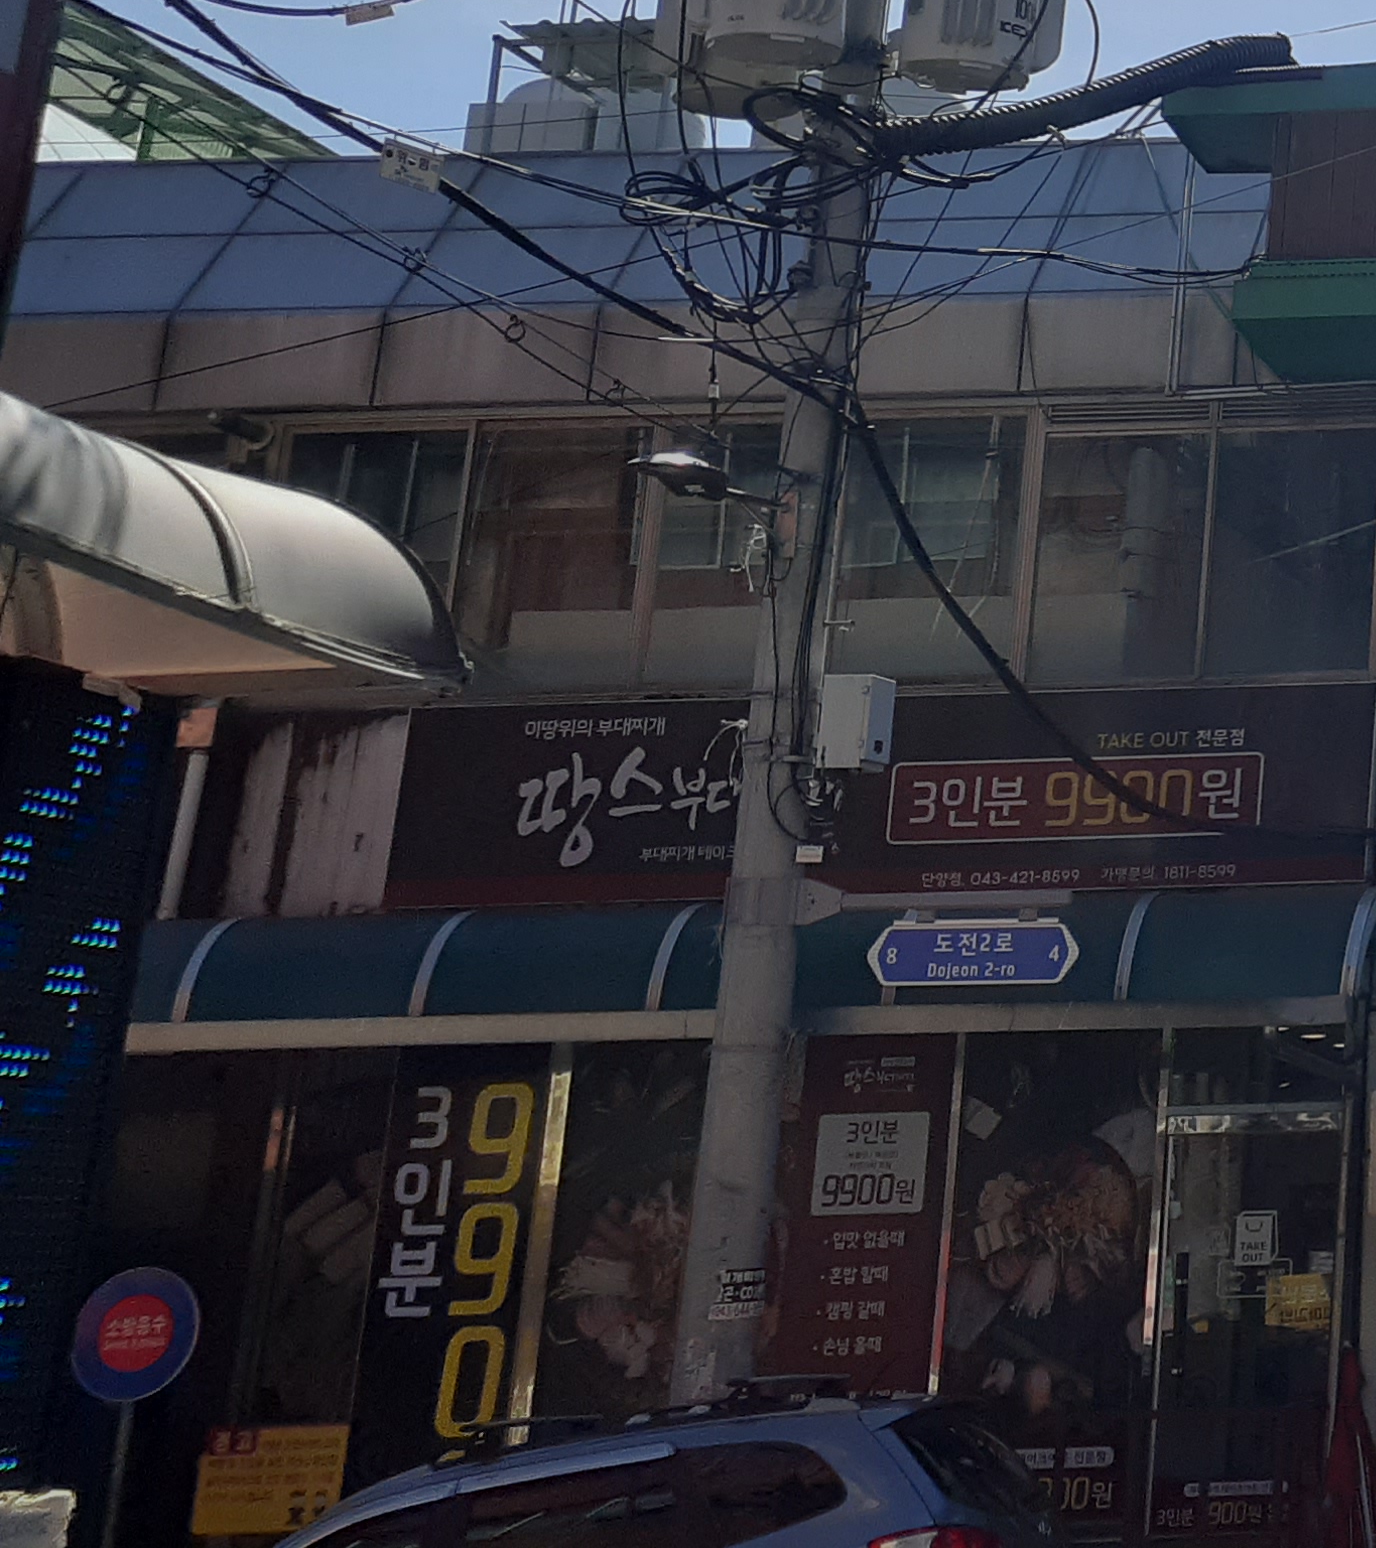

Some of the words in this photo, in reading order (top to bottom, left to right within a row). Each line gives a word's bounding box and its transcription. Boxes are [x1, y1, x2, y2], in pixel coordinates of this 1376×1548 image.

[596, 716, 666, 737] 부대찌개
[1098, 732, 1144, 750] TAKE
[1150, 731, 1190, 748] OUT
[1196, 728, 1245, 748] 전문점
[516, 746, 742, 868] 땅스부대
[908, 776, 1028, 829] 3인분
[885, 946, 898, 965] 8
[934, 932, 1014, 956] 도전2로
[1048, 944, 1060, 962] 4
[926, 961, 978, 980] Dojeon
[984, 961, 1016, 978] 2-ro
[847, 1119, 898, 1145] 3인분
[376, 1084, 453, 1319] 3인분
[821, 1173, 916, 1208] 9900원
[1239, 1241, 1269, 1252] TAKE
[433, 1081, 536, 1452] 990
[1242, 1253, 1264, 1264] OUT
